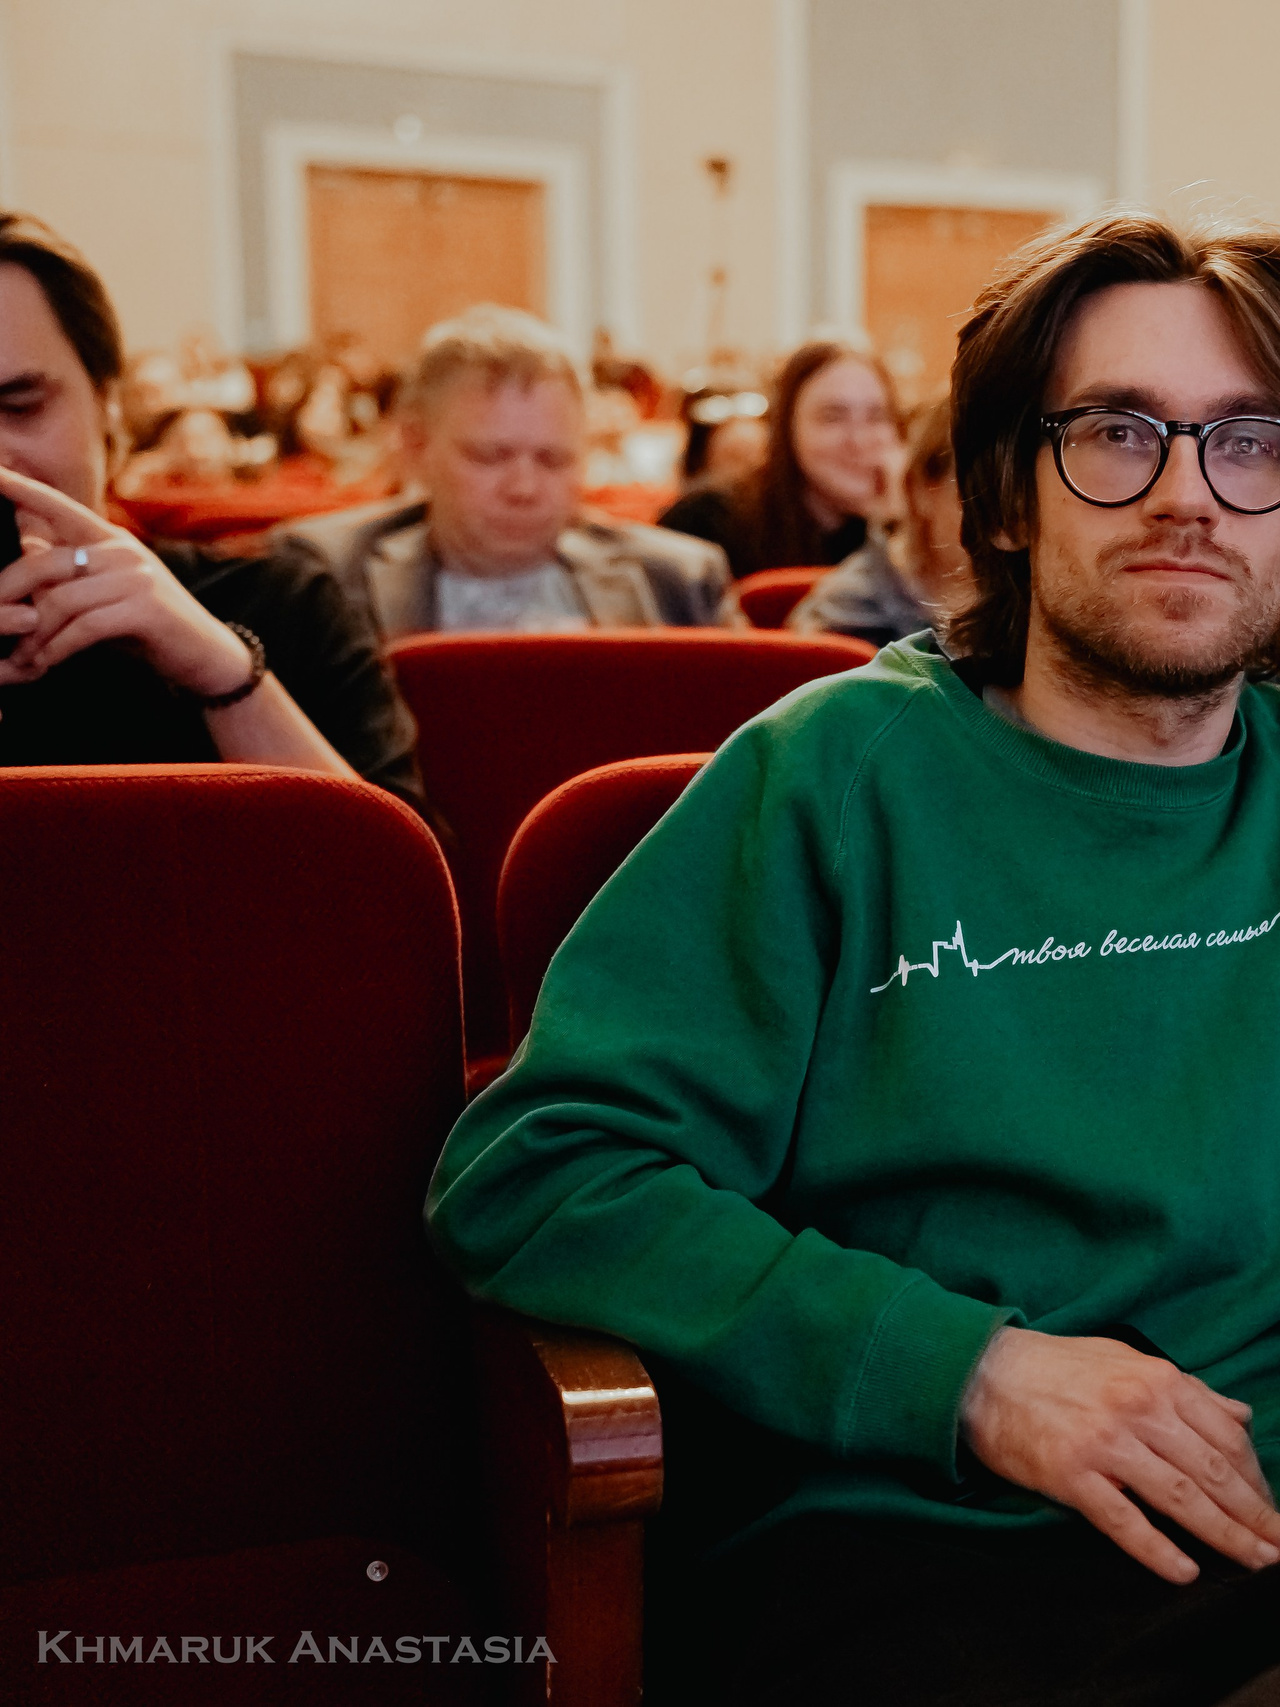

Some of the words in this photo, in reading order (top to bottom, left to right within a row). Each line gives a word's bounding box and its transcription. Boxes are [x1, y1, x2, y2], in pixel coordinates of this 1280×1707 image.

[1009, 937, 1092, 965] твоя
[1100, 930, 1201, 956] веселая
[1205, 920, 1275, 946] семья
